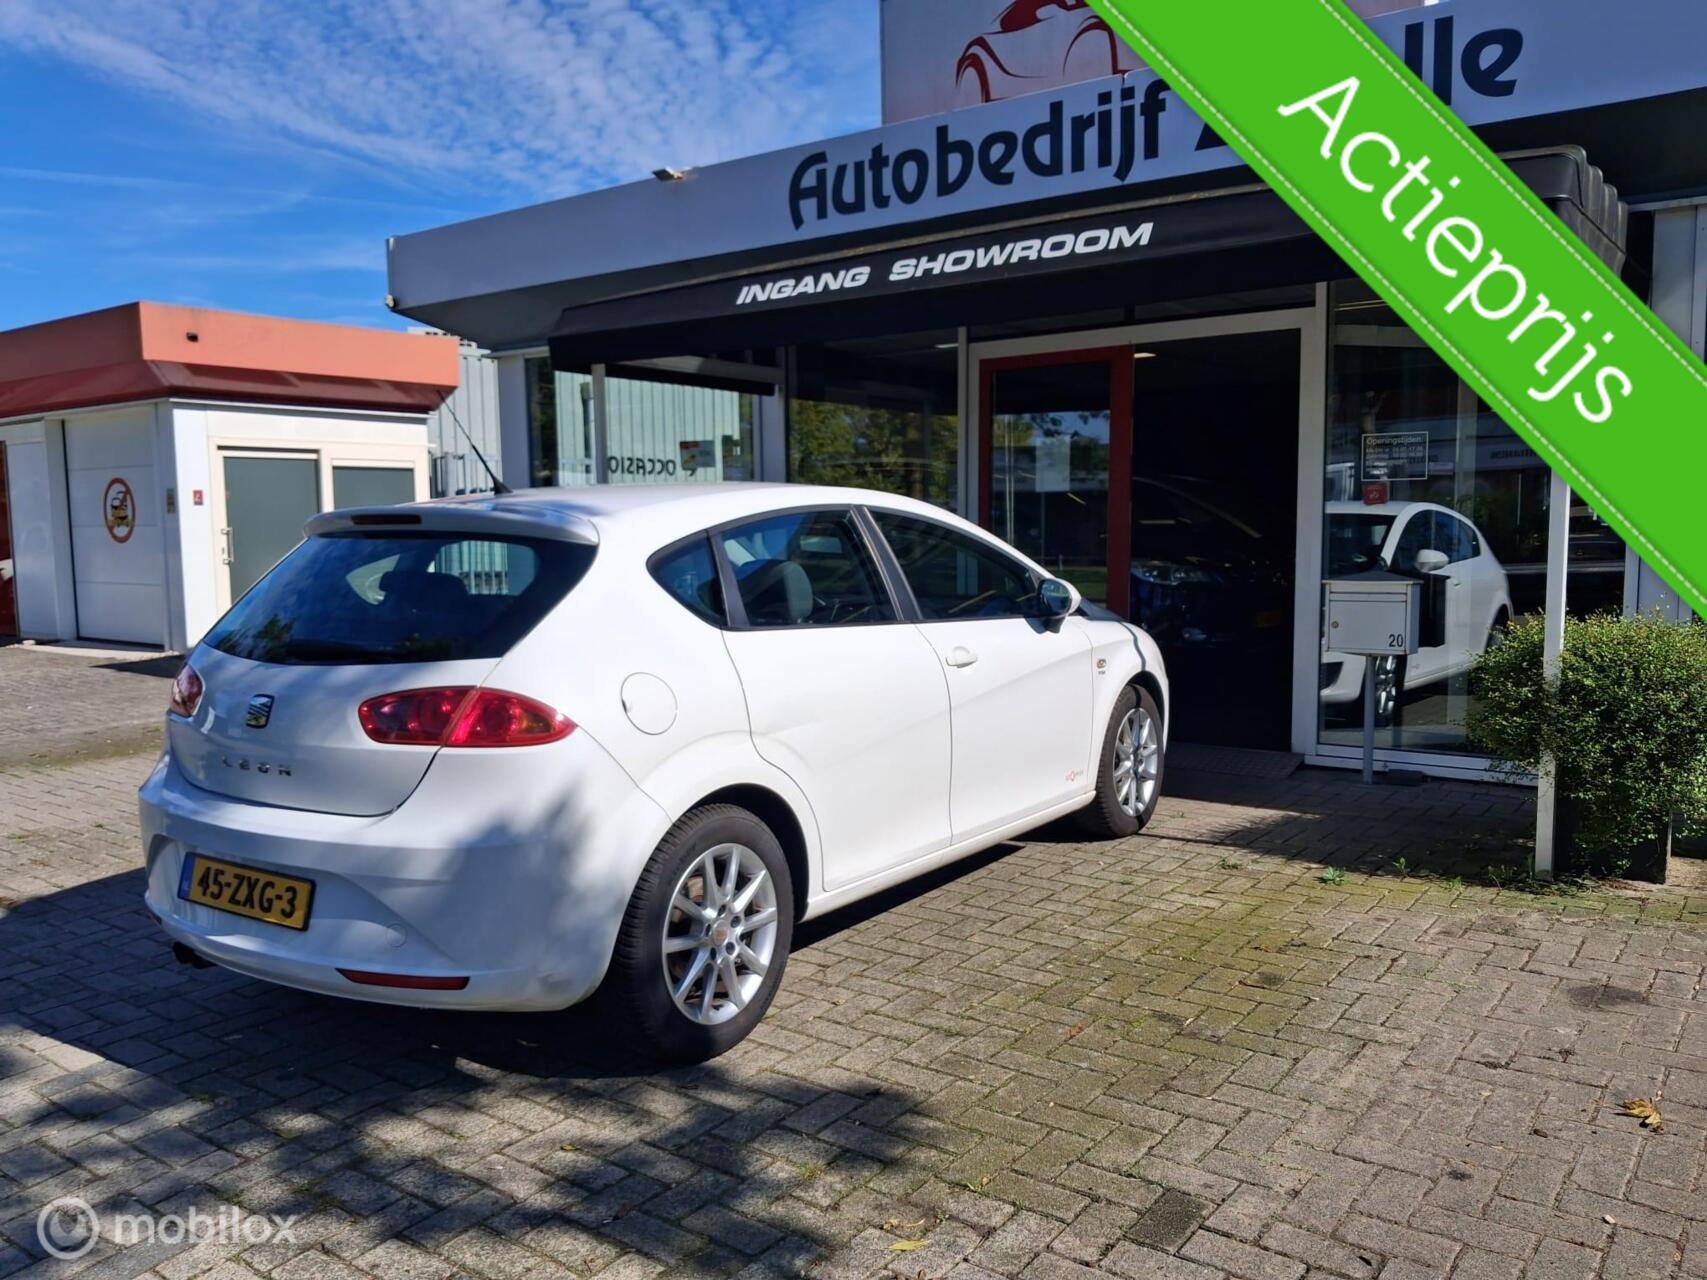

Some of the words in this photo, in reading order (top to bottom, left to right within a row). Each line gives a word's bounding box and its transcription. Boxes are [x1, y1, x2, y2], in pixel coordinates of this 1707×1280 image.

[788, 78, 1172, 231] Autobedrijf
[736, 266, 871, 305] INGANG
[889, 222, 1154, 281] SHOWROOM
[1388, 633, 1404, 647] 20
[222, 756, 292, 776] LEON
[197, 866, 298, 919] 45-ZXG-3
